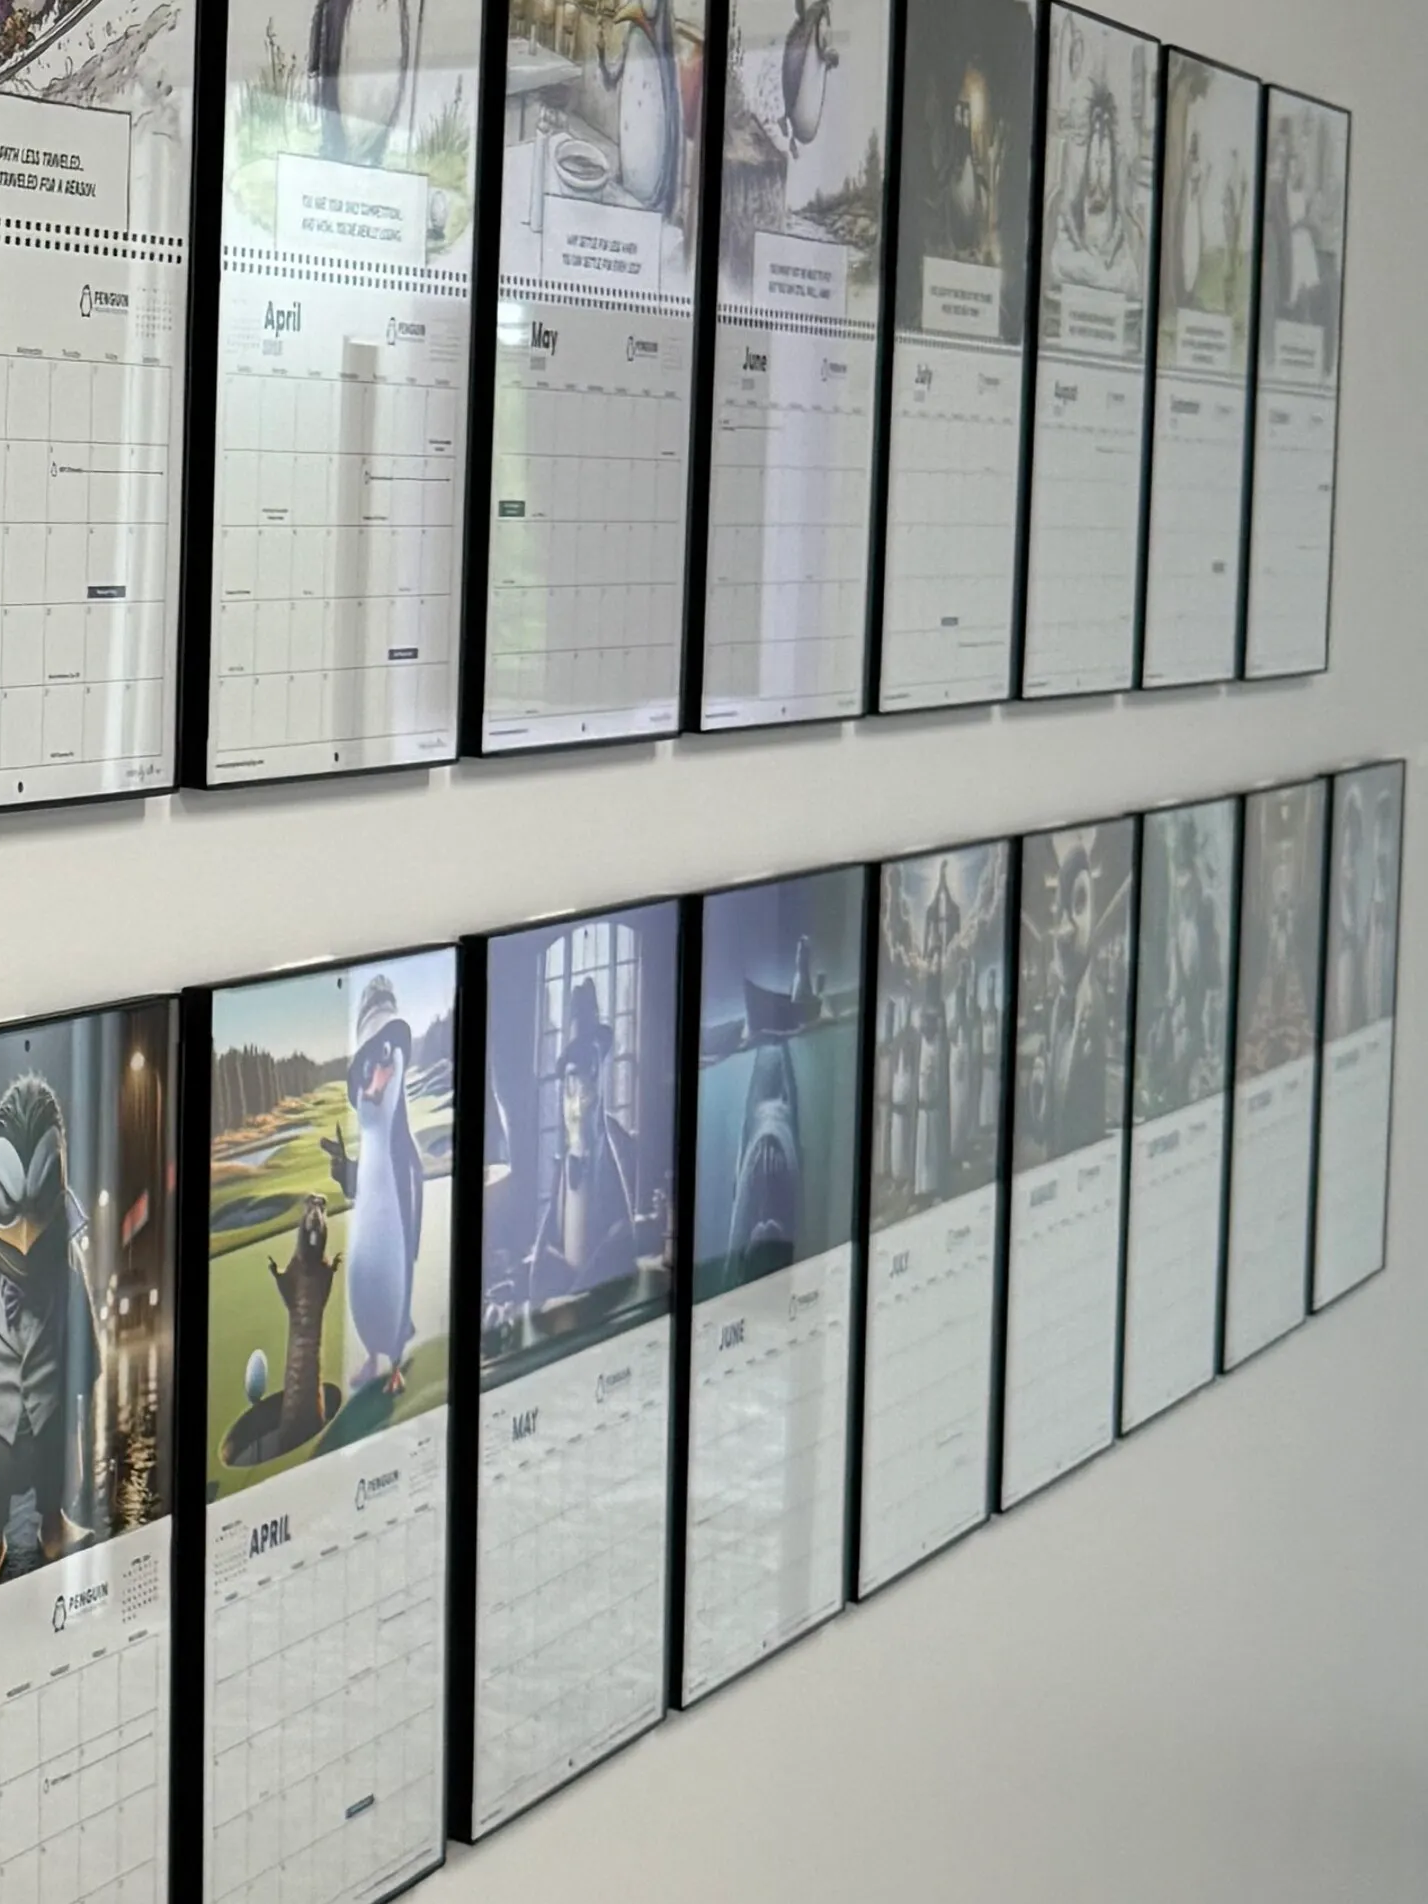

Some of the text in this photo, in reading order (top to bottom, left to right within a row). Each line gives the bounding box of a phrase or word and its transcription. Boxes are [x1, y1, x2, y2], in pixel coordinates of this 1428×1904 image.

[264, 301, 302, 337] April
[531, 321, 558, 356] May
[511, 1407, 539, 1442] MAY
[248, 1514, 292, 1559] APRIL
